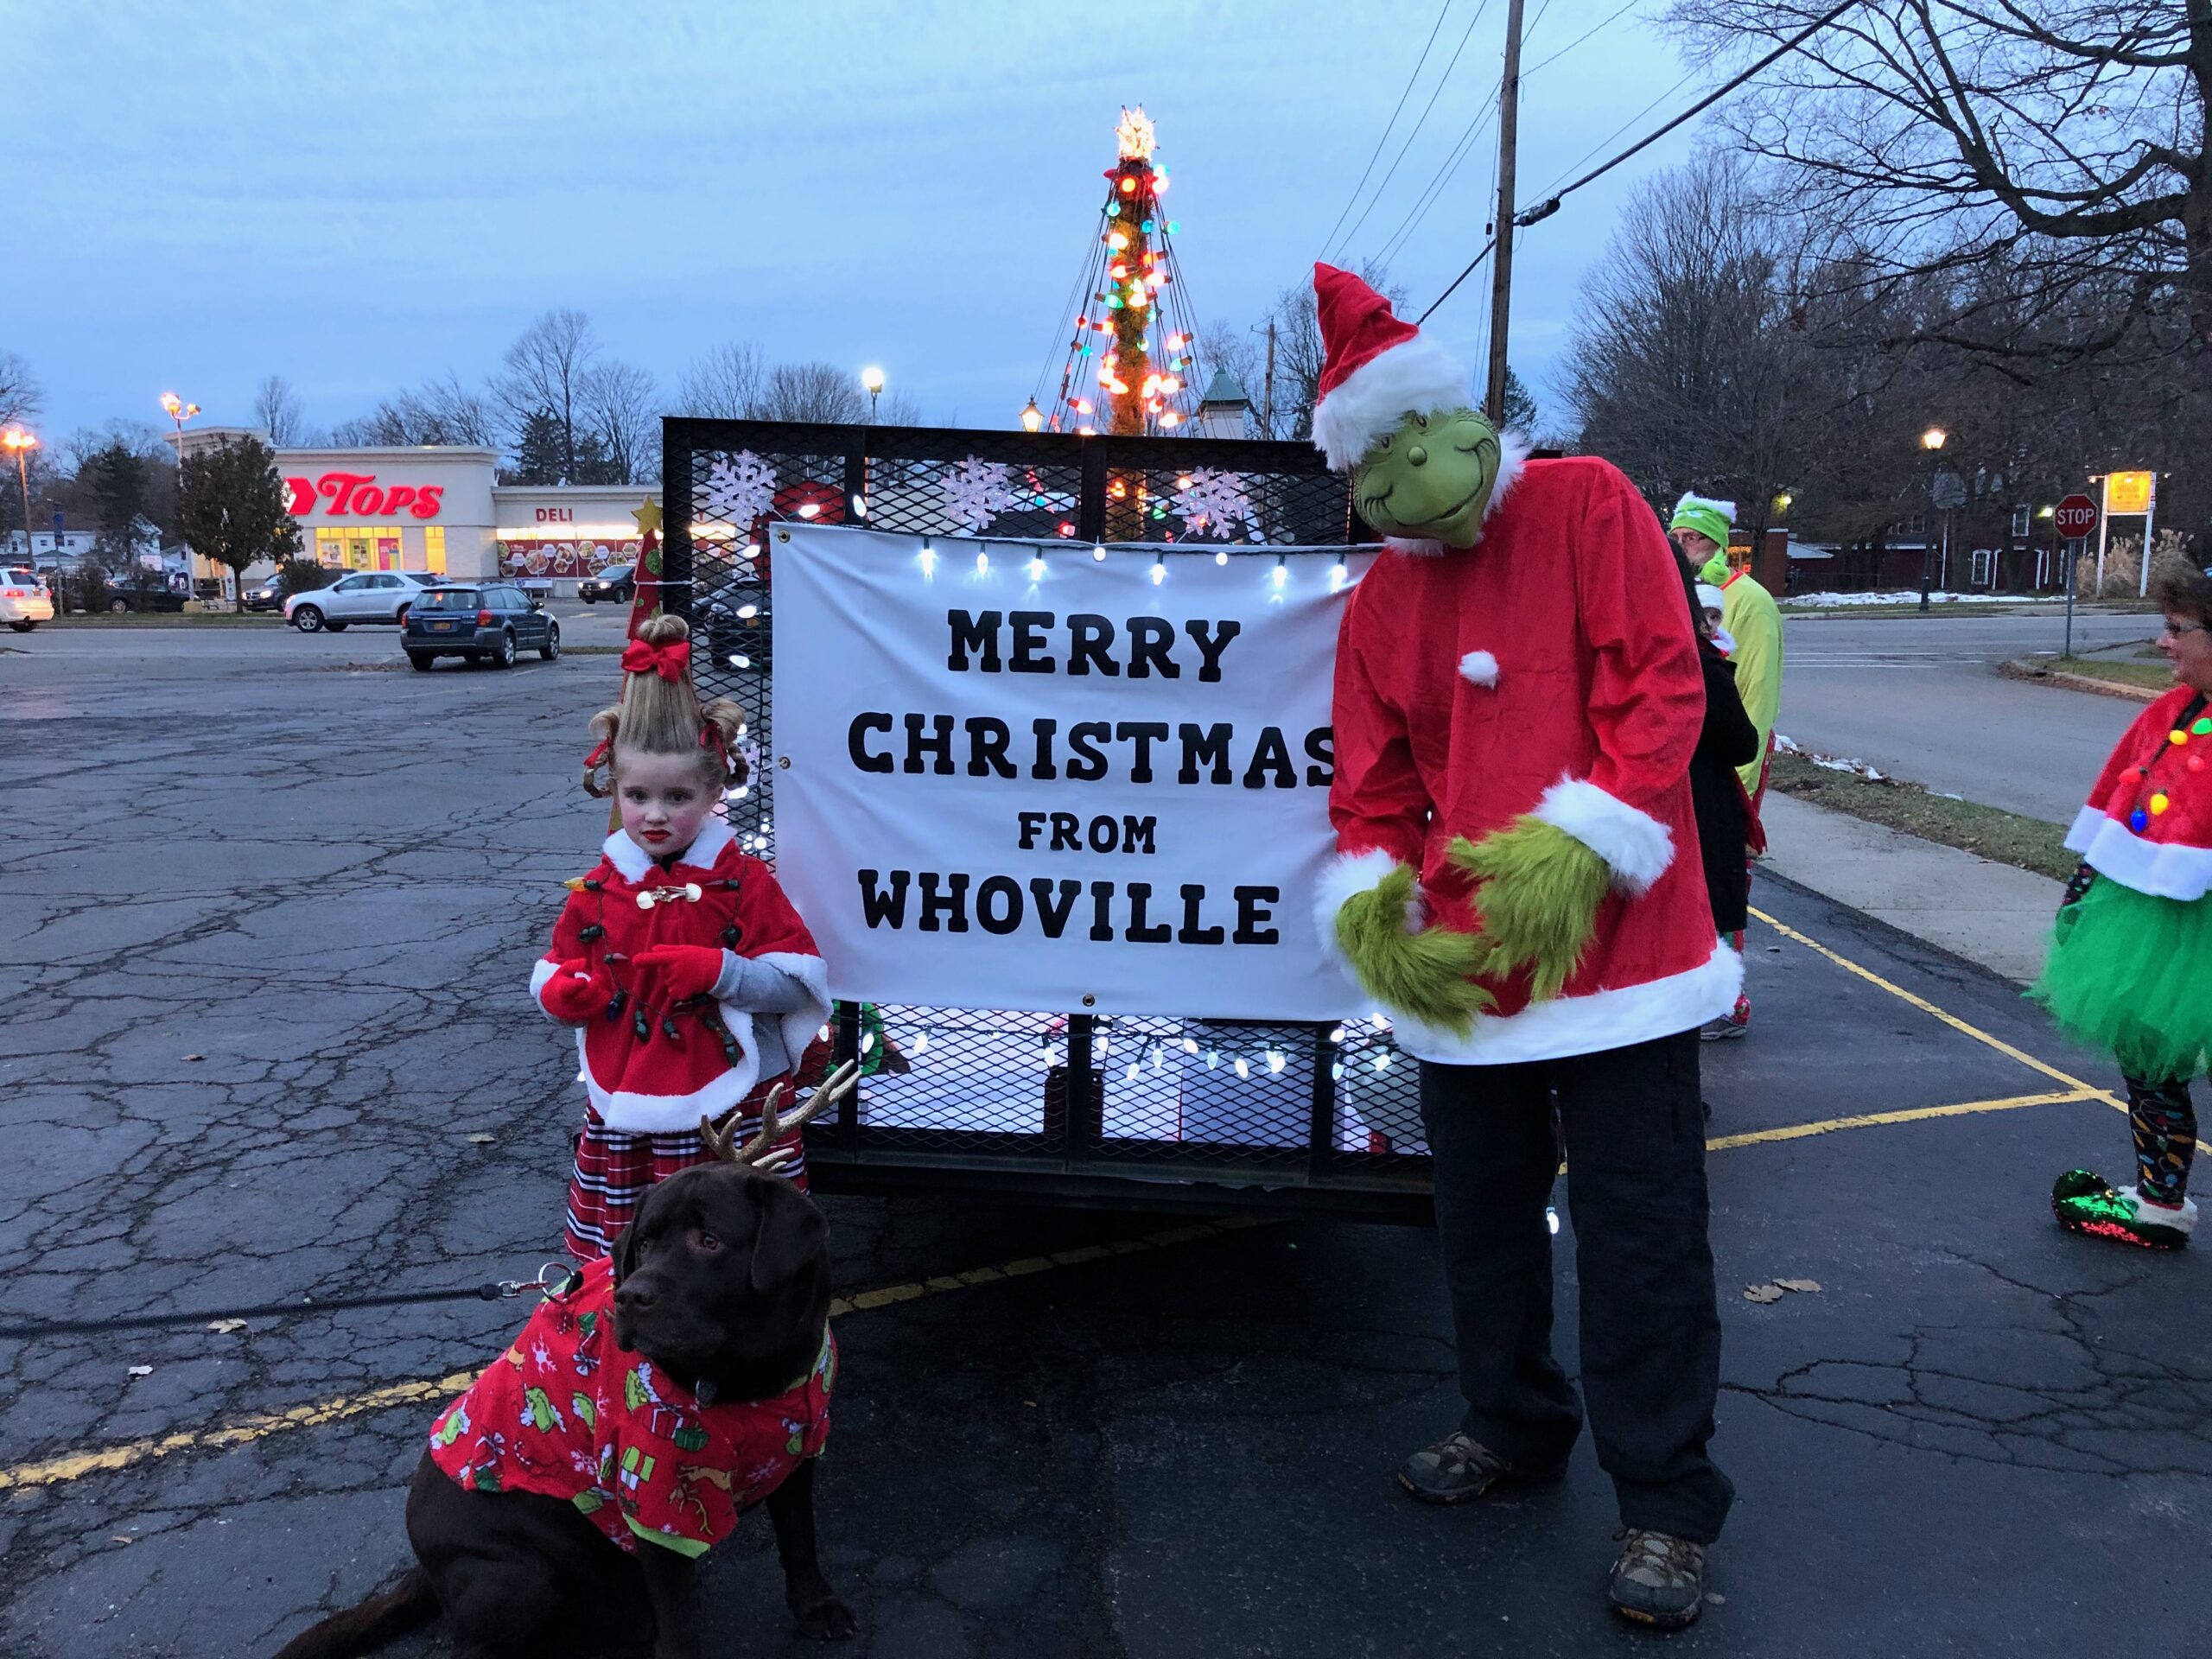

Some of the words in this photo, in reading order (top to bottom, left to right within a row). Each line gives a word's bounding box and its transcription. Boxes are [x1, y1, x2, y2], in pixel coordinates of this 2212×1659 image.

[536, 508, 573, 522] DELI
[2057, 508, 2094, 524] STOP
[947, 609, 1241, 683] MERRY
[848, 711, 1334, 789] CHRISTMAS
[1018, 811, 1158, 855] FROM
[857, 868, 1280, 945] WHOVILLE
